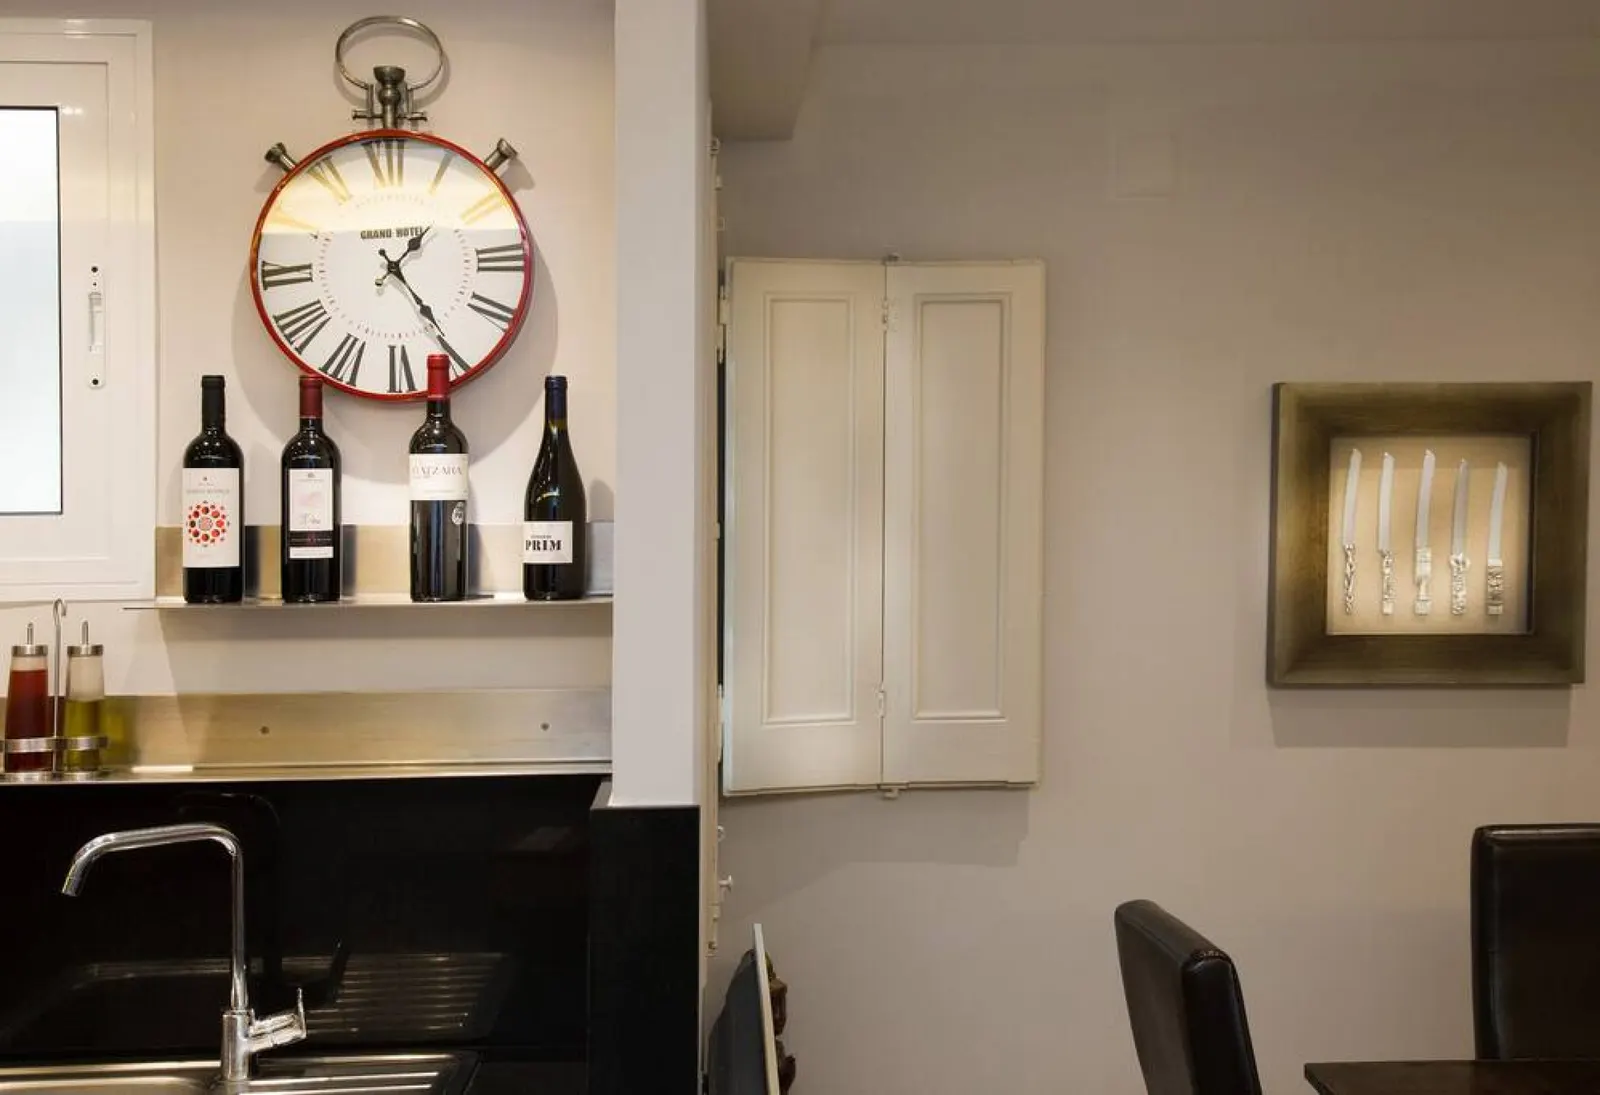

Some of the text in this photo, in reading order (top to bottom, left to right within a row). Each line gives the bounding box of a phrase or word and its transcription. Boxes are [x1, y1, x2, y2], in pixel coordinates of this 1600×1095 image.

[360, 225, 423, 240] GRAND HOTEL
[525, 539, 562, 551] PRIM
